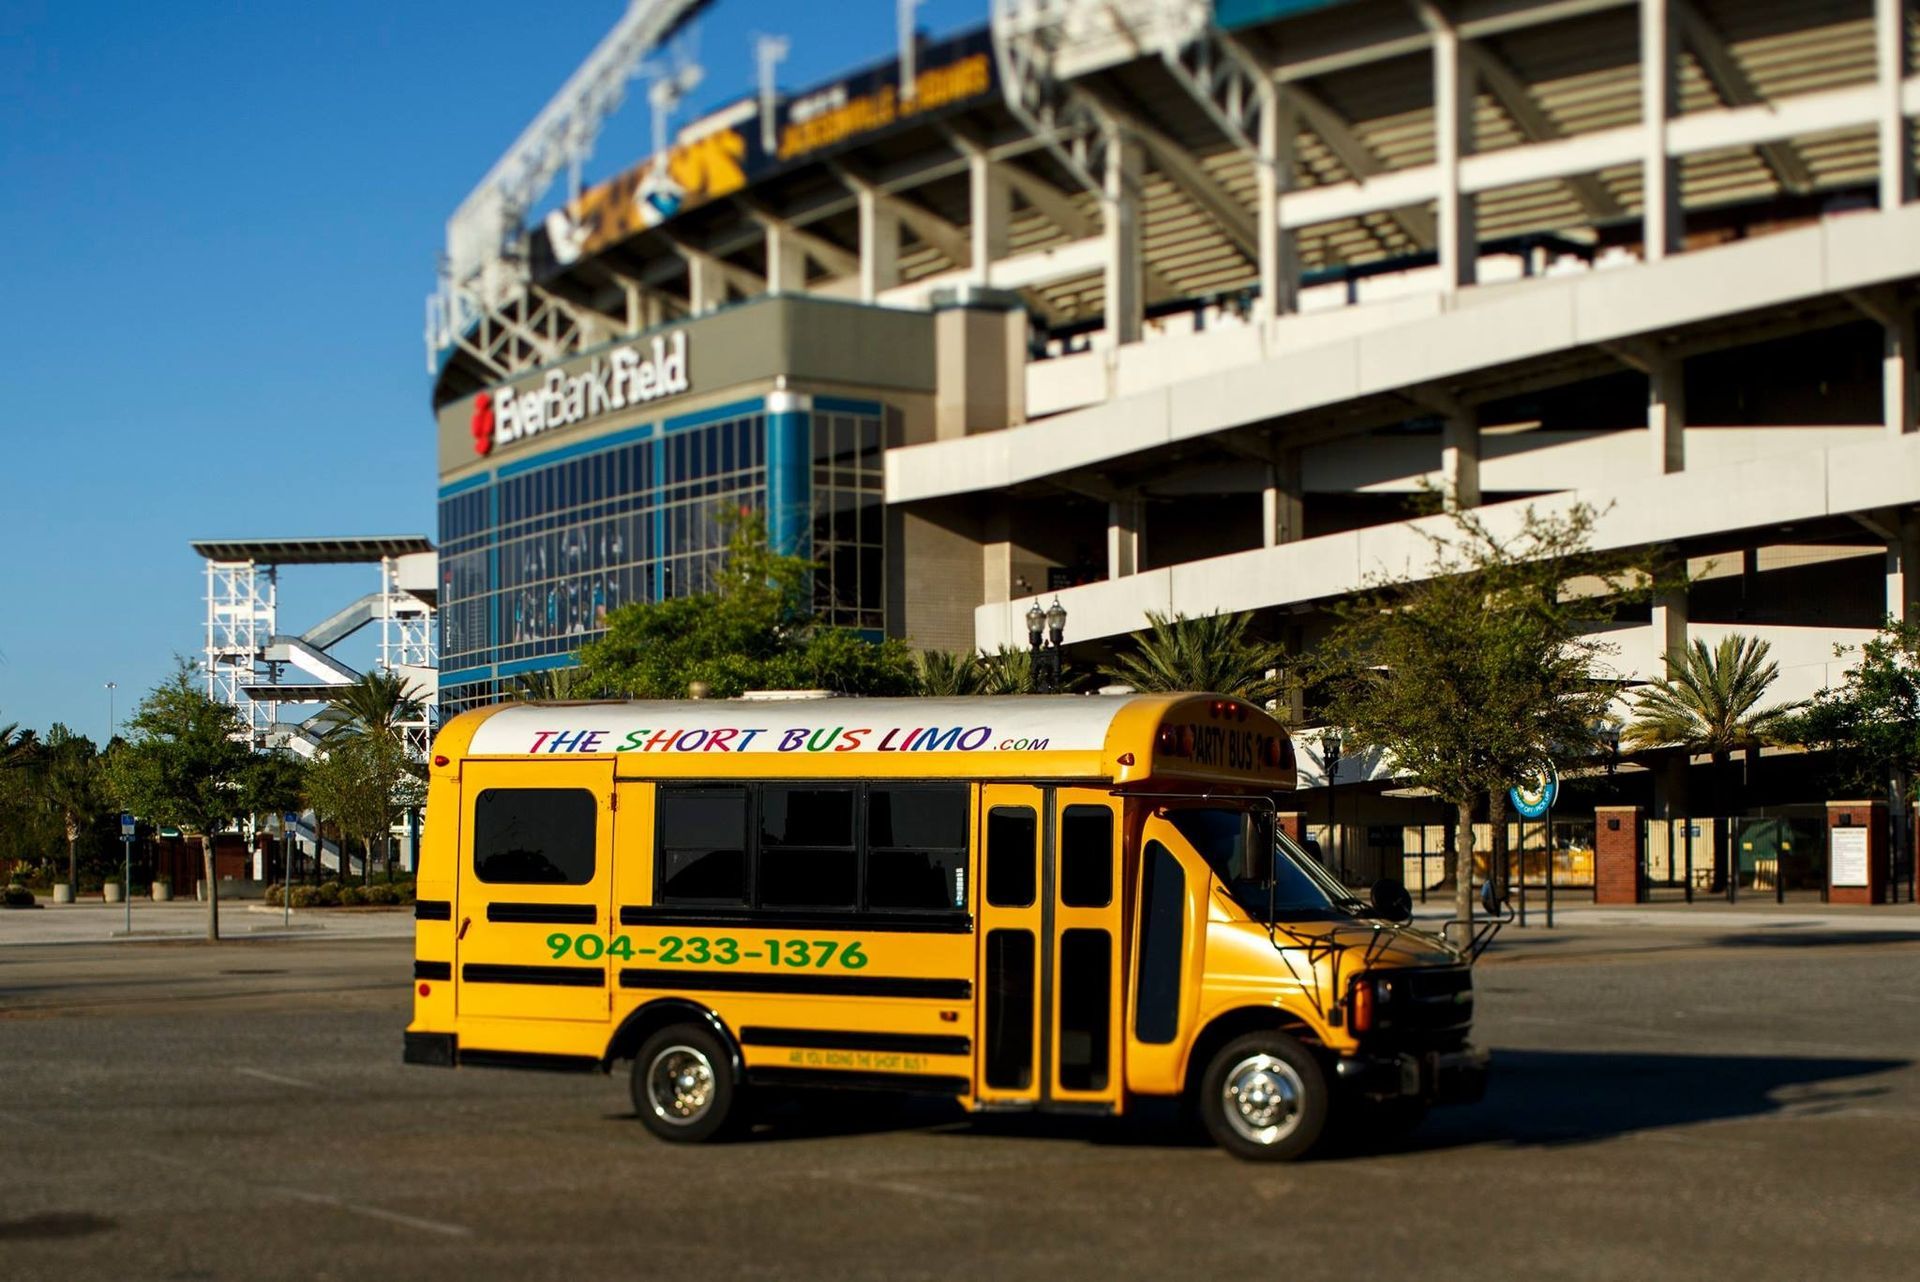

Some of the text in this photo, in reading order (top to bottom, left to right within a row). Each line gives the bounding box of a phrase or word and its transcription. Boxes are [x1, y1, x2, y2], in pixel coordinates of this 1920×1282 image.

[529, 730, 610, 754] THE
[616, 728, 767, 752] SHORT
[777, 726, 872, 752] BUS
[1229, 729, 1252, 770] BUS
[546, 932, 868, 969] 904-233-1376
[856, 1052, 872, 1067] THE
[874, 1053, 901, 1068] SHORT
[904, 1055, 921, 1070] BUS
